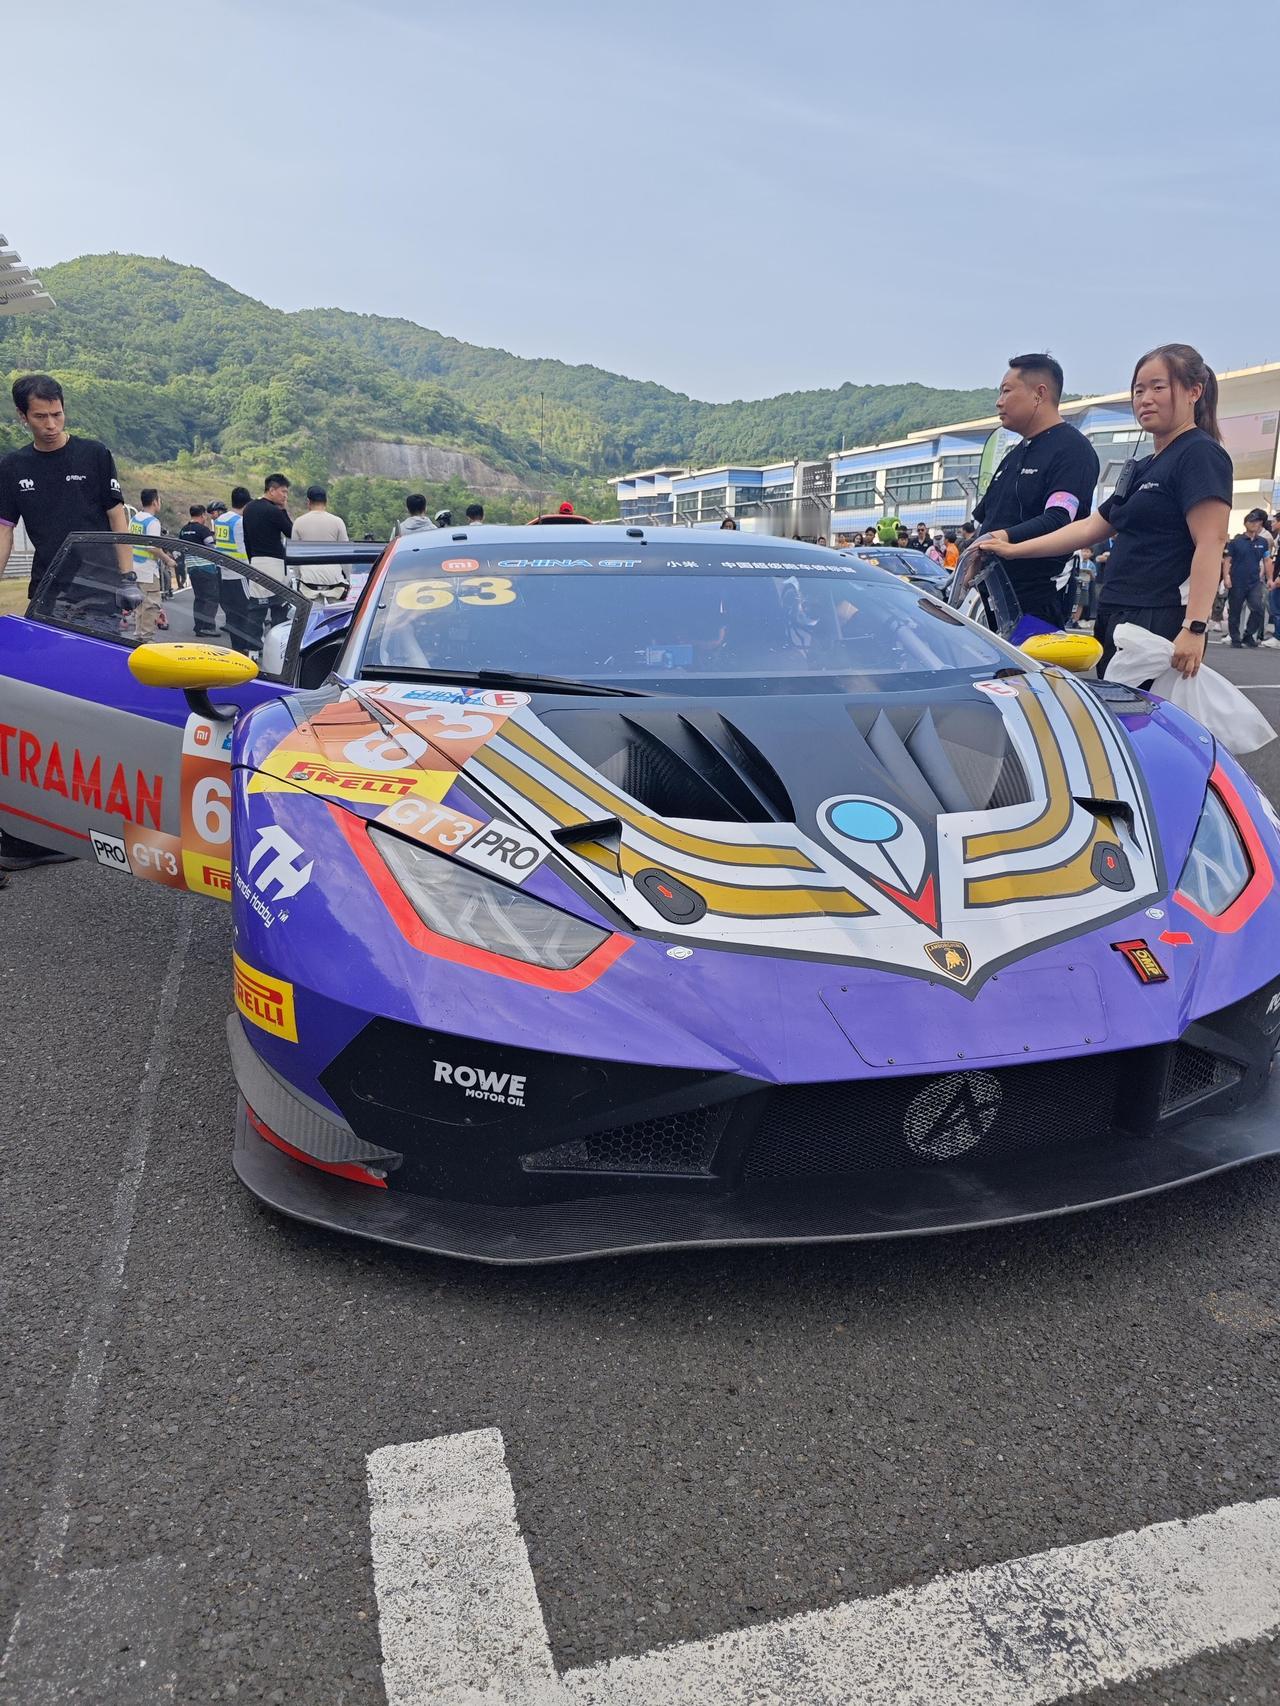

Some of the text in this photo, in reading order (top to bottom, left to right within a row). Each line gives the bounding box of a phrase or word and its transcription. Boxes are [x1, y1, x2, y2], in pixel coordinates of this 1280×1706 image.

[498, 559, 642, 569] CHINA GT
[666, 560, 699, 569] 小米
[395, 577, 517, 610] 63
[494, 693, 518, 706] E
[343, 707, 494, 771] 63
[285, 761, 418, 796] PIRELLI
[387, 798, 474, 846] GT3
[94, 839, 126, 864] PRO
[132, 842, 178, 877] GT3
[470, 829, 540, 870] PRO
[249, 892, 275, 929] Hobby
[1135, 949, 1161, 976] OMP
[432, 1059, 527, 1097] ROWE
[465, 1088, 526, 1107] MOTOR OIL
